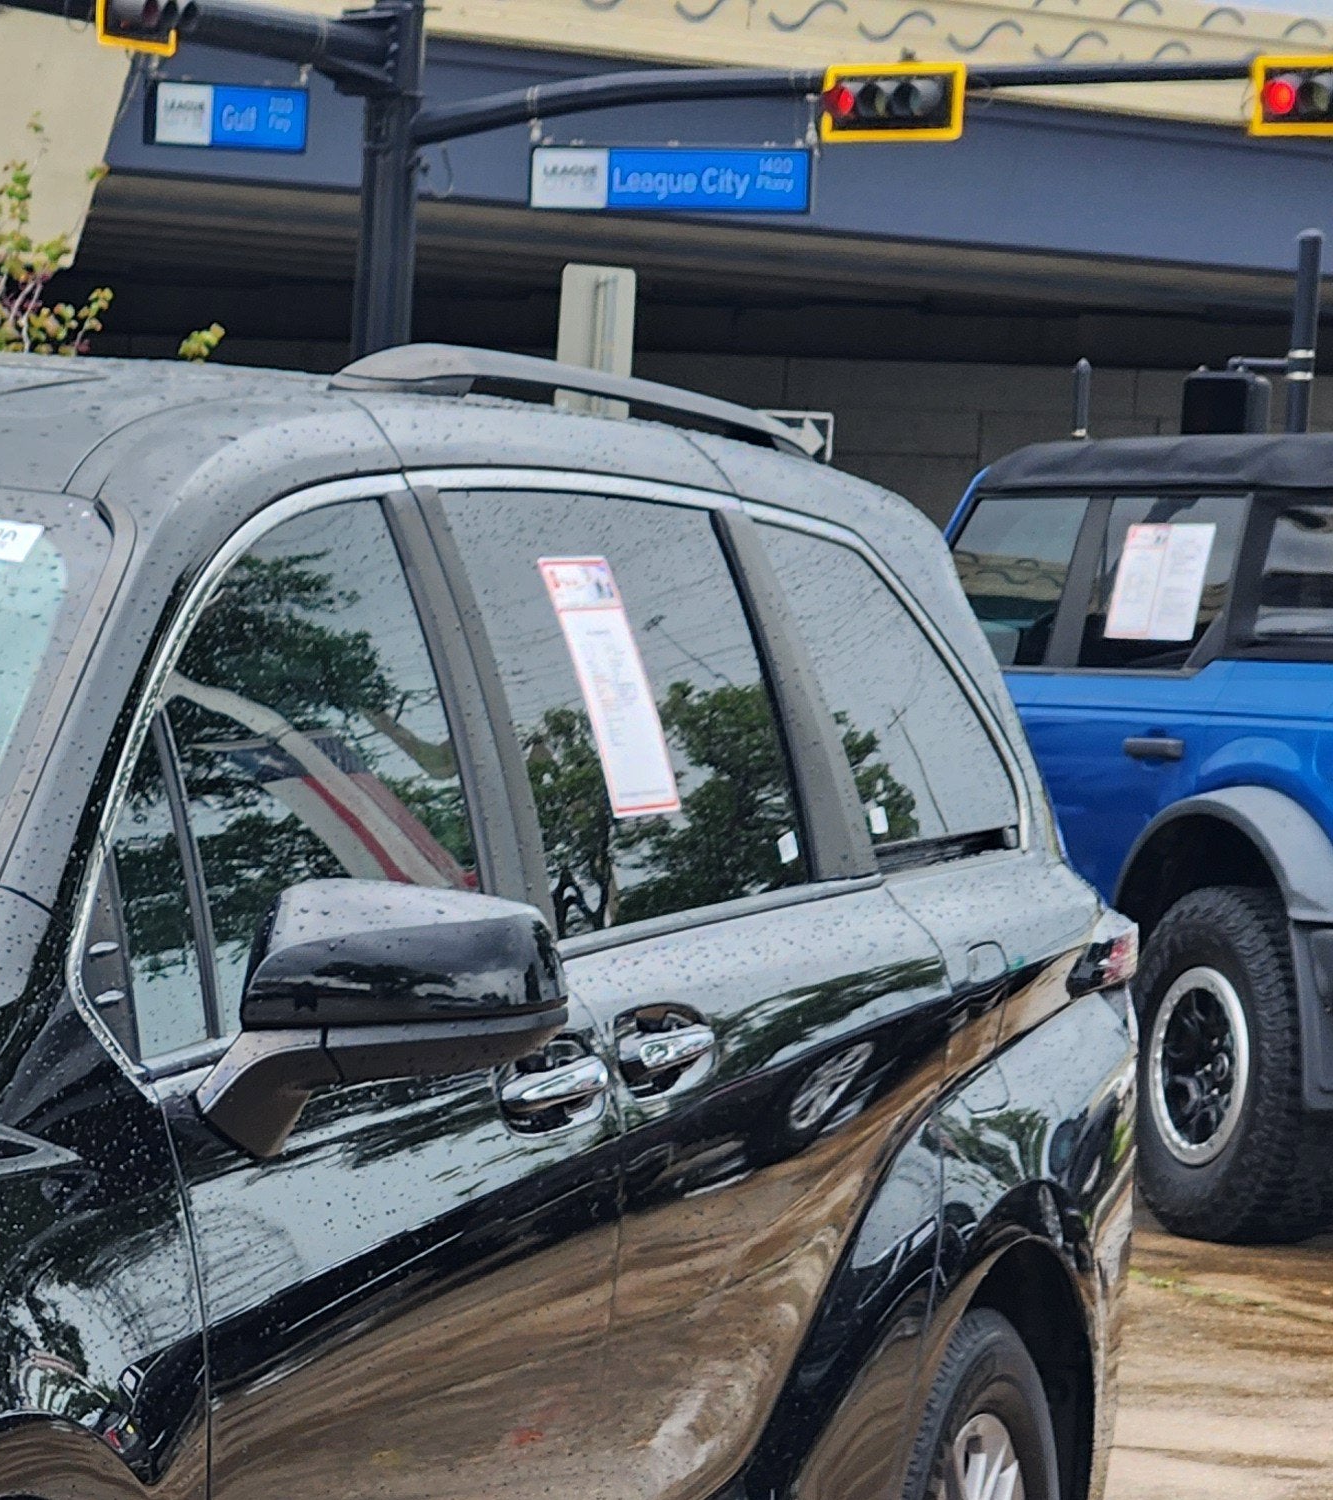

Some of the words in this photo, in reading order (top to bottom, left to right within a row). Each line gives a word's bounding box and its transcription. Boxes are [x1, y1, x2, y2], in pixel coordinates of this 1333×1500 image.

[221, 104, 258, 131] Gulf
[612, 167, 698, 200] League
[701, 167, 750, 199] City
